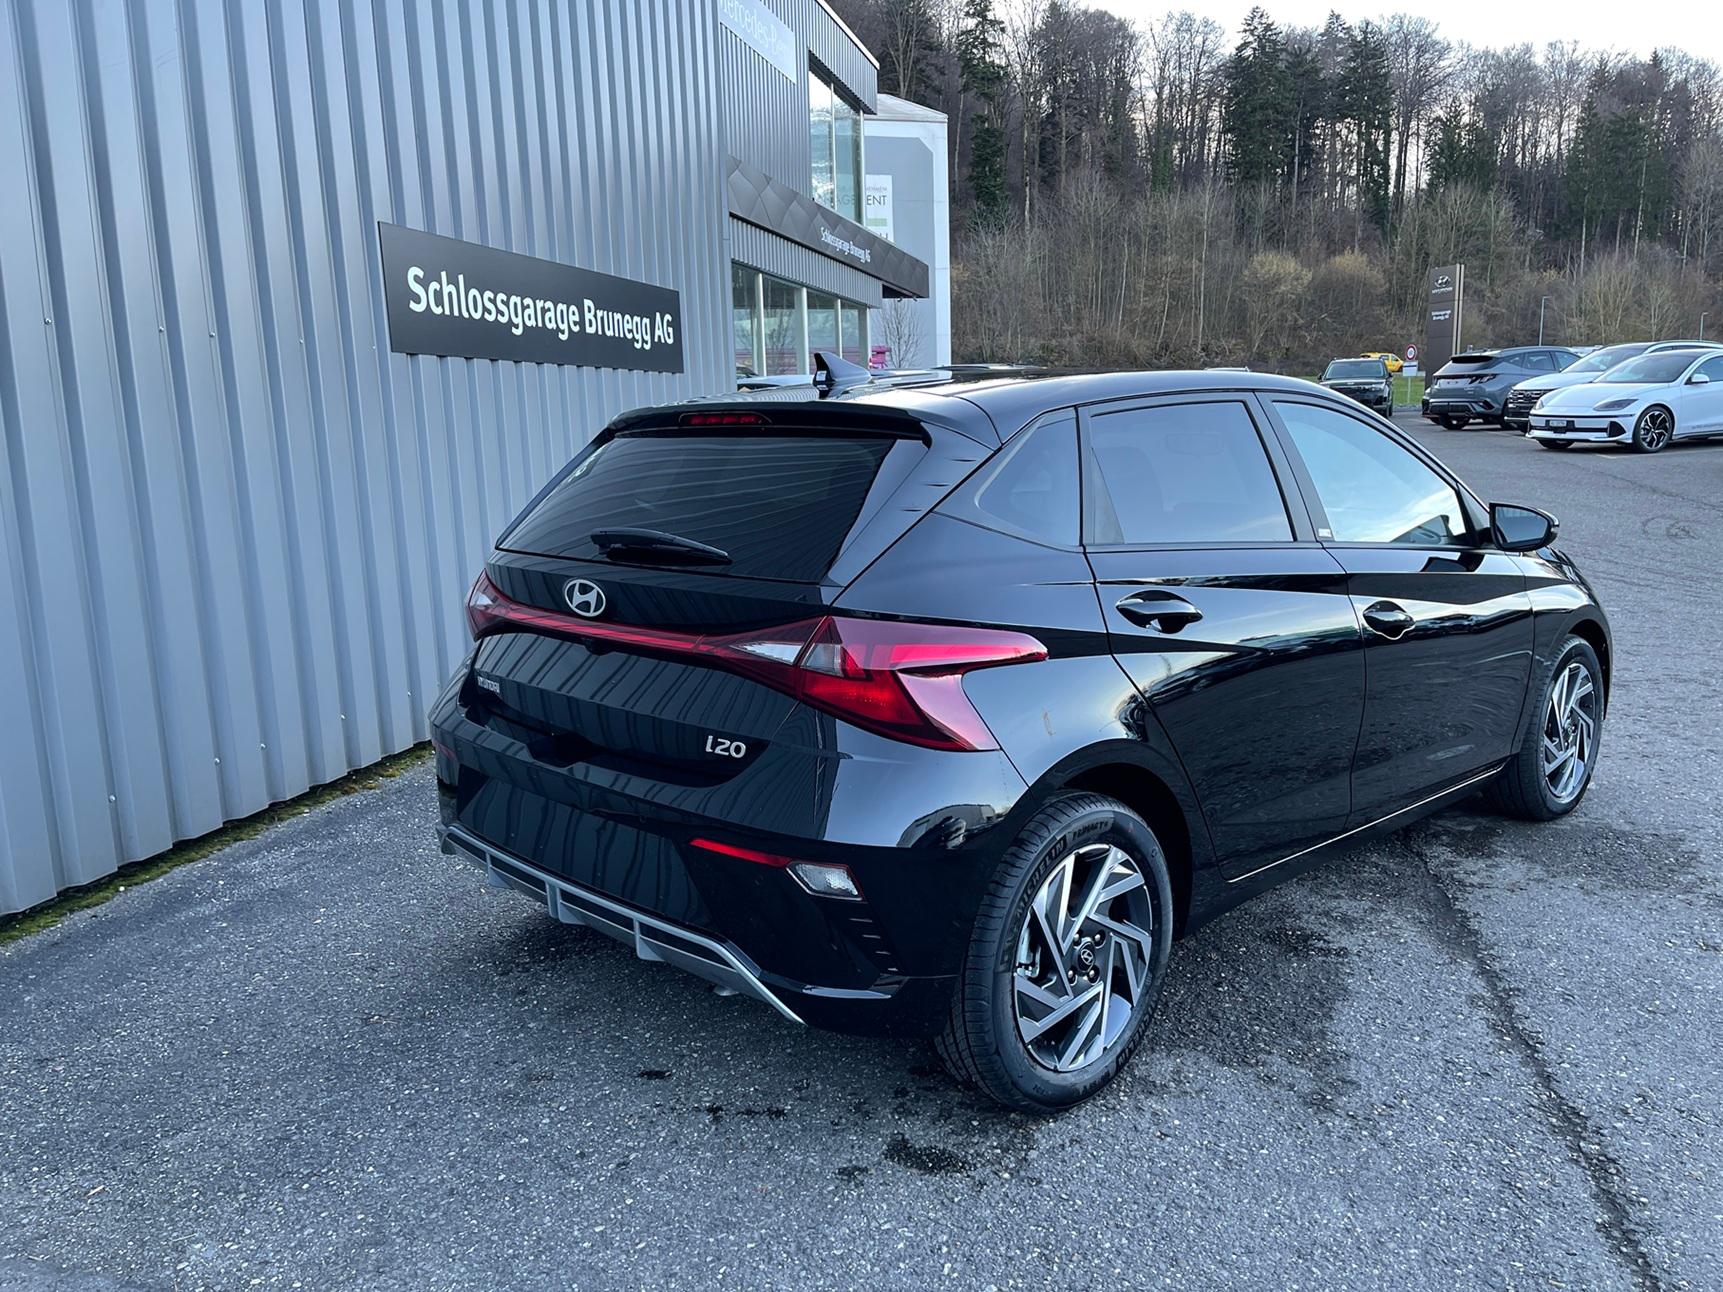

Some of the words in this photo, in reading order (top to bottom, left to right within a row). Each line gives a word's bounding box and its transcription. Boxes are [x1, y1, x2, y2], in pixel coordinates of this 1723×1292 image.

[407, 266, 580, 341] Schlossgarage
[583, 299, 651, 350] Brunegg
[654, 312, 674, 344] AG
[1015, 837, 1066, 919] MICHELIN
